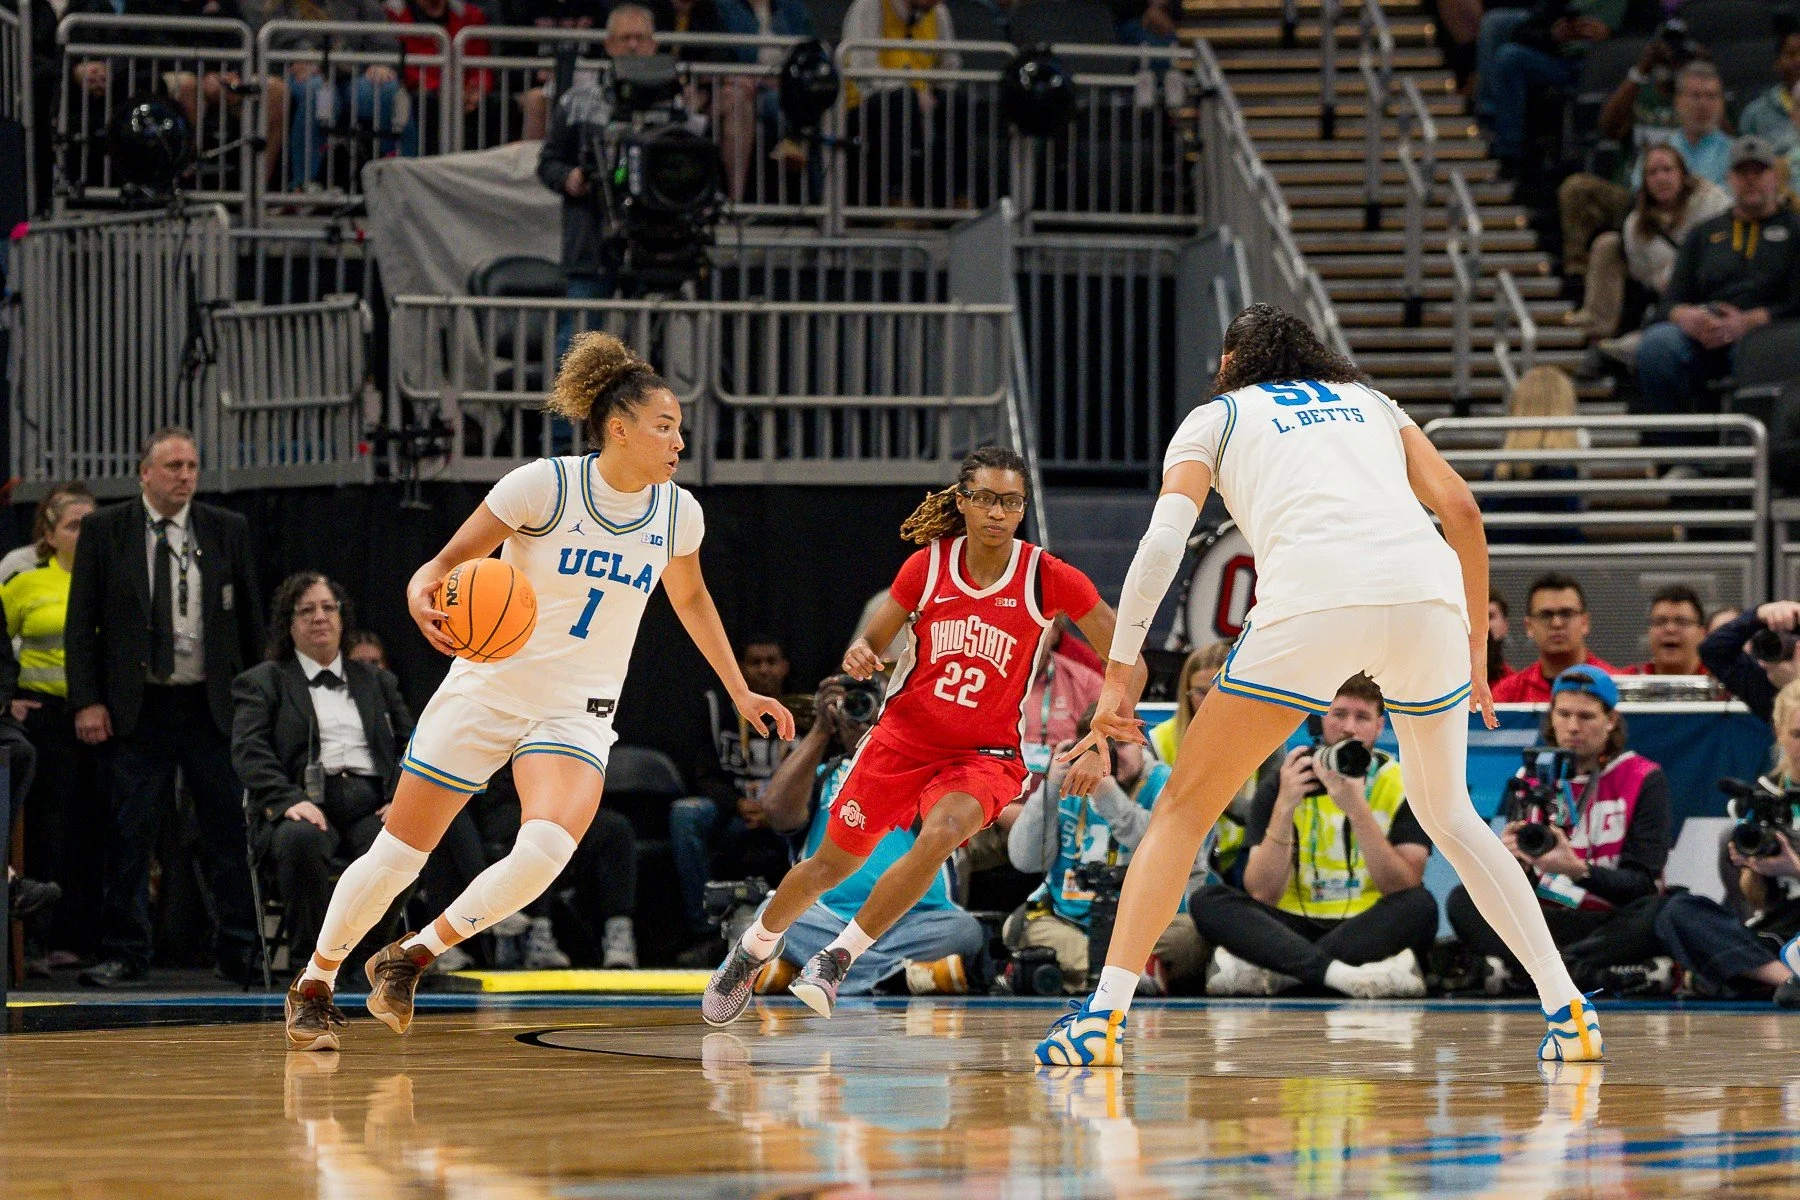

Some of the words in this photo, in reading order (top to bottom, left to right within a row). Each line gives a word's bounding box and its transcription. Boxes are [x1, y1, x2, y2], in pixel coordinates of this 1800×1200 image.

[1257, 379, 1341, 406] 51
[1272, 417, 1295, 434] L.
[1295, 407, 1365, 426] BETTS
[558, 548, 653, 594] UCLA
[569, 587, 605, 640] 1
[934, 662, 986, 709] 22
